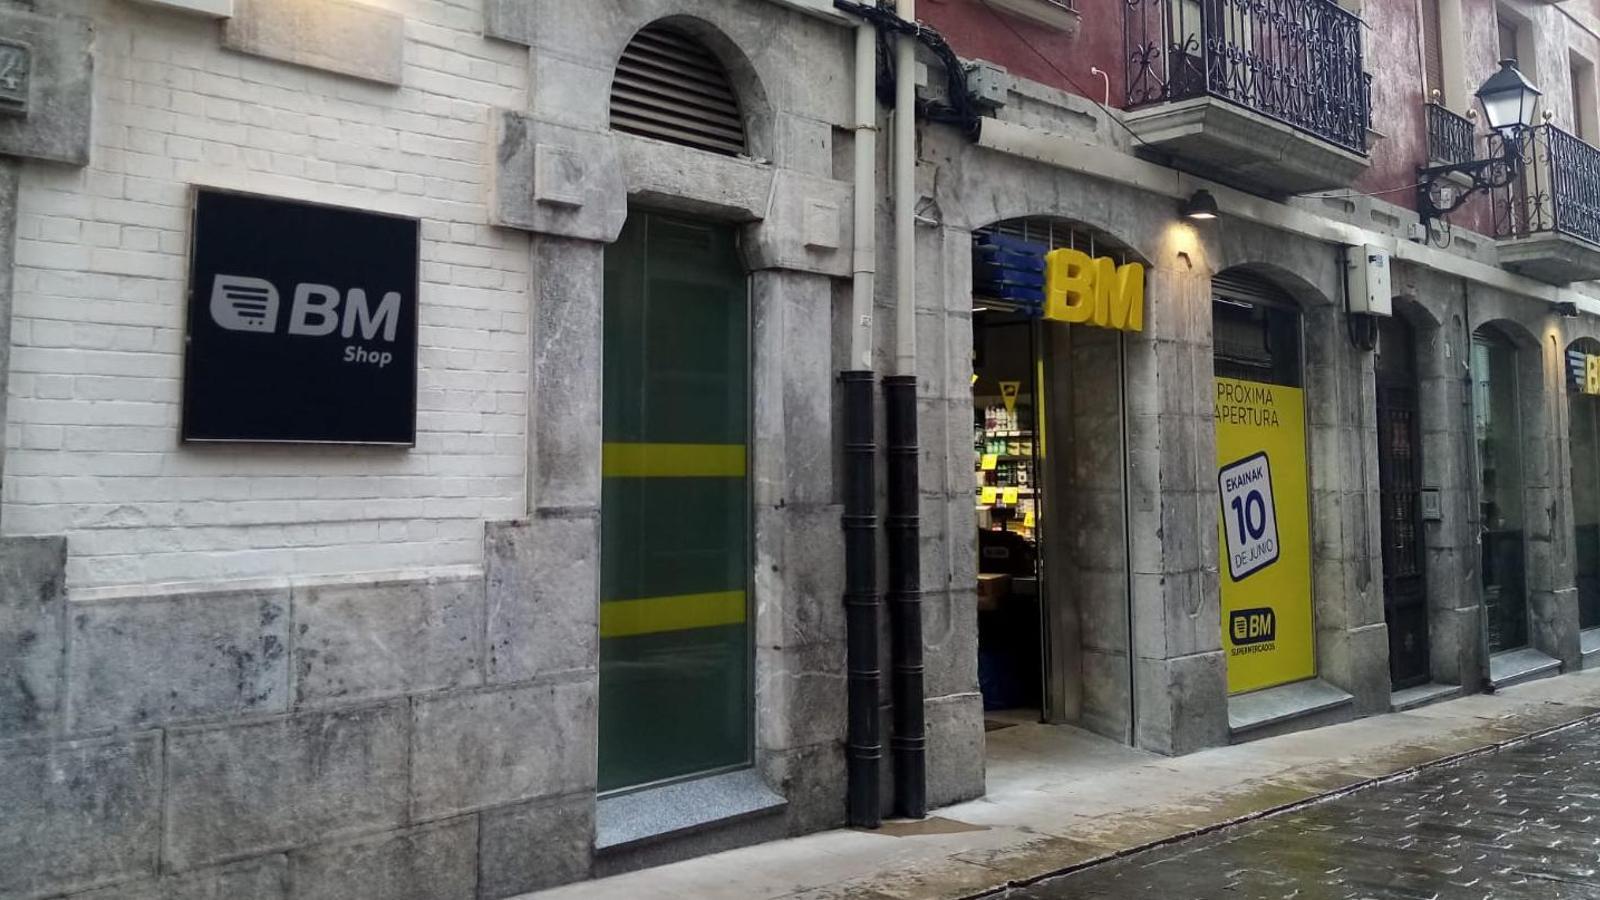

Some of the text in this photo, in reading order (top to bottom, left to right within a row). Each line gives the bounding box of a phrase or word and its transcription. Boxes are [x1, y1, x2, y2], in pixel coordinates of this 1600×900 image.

[1043, 247, 1144, 332] BM
[288, 282, 402, 342] BM
[343, 345, 393, 368] Shop
[1584, 353, 1600, 395] B
[1214, 404, 1279, 427] APERTURA
[1226, 466, 1264, 492] EKAINAK
[1231, 489, 1266, 546] 10
[1235, 538, 1274, 569] DE JUNIO
[1249, 613, 1272, 638] BM
